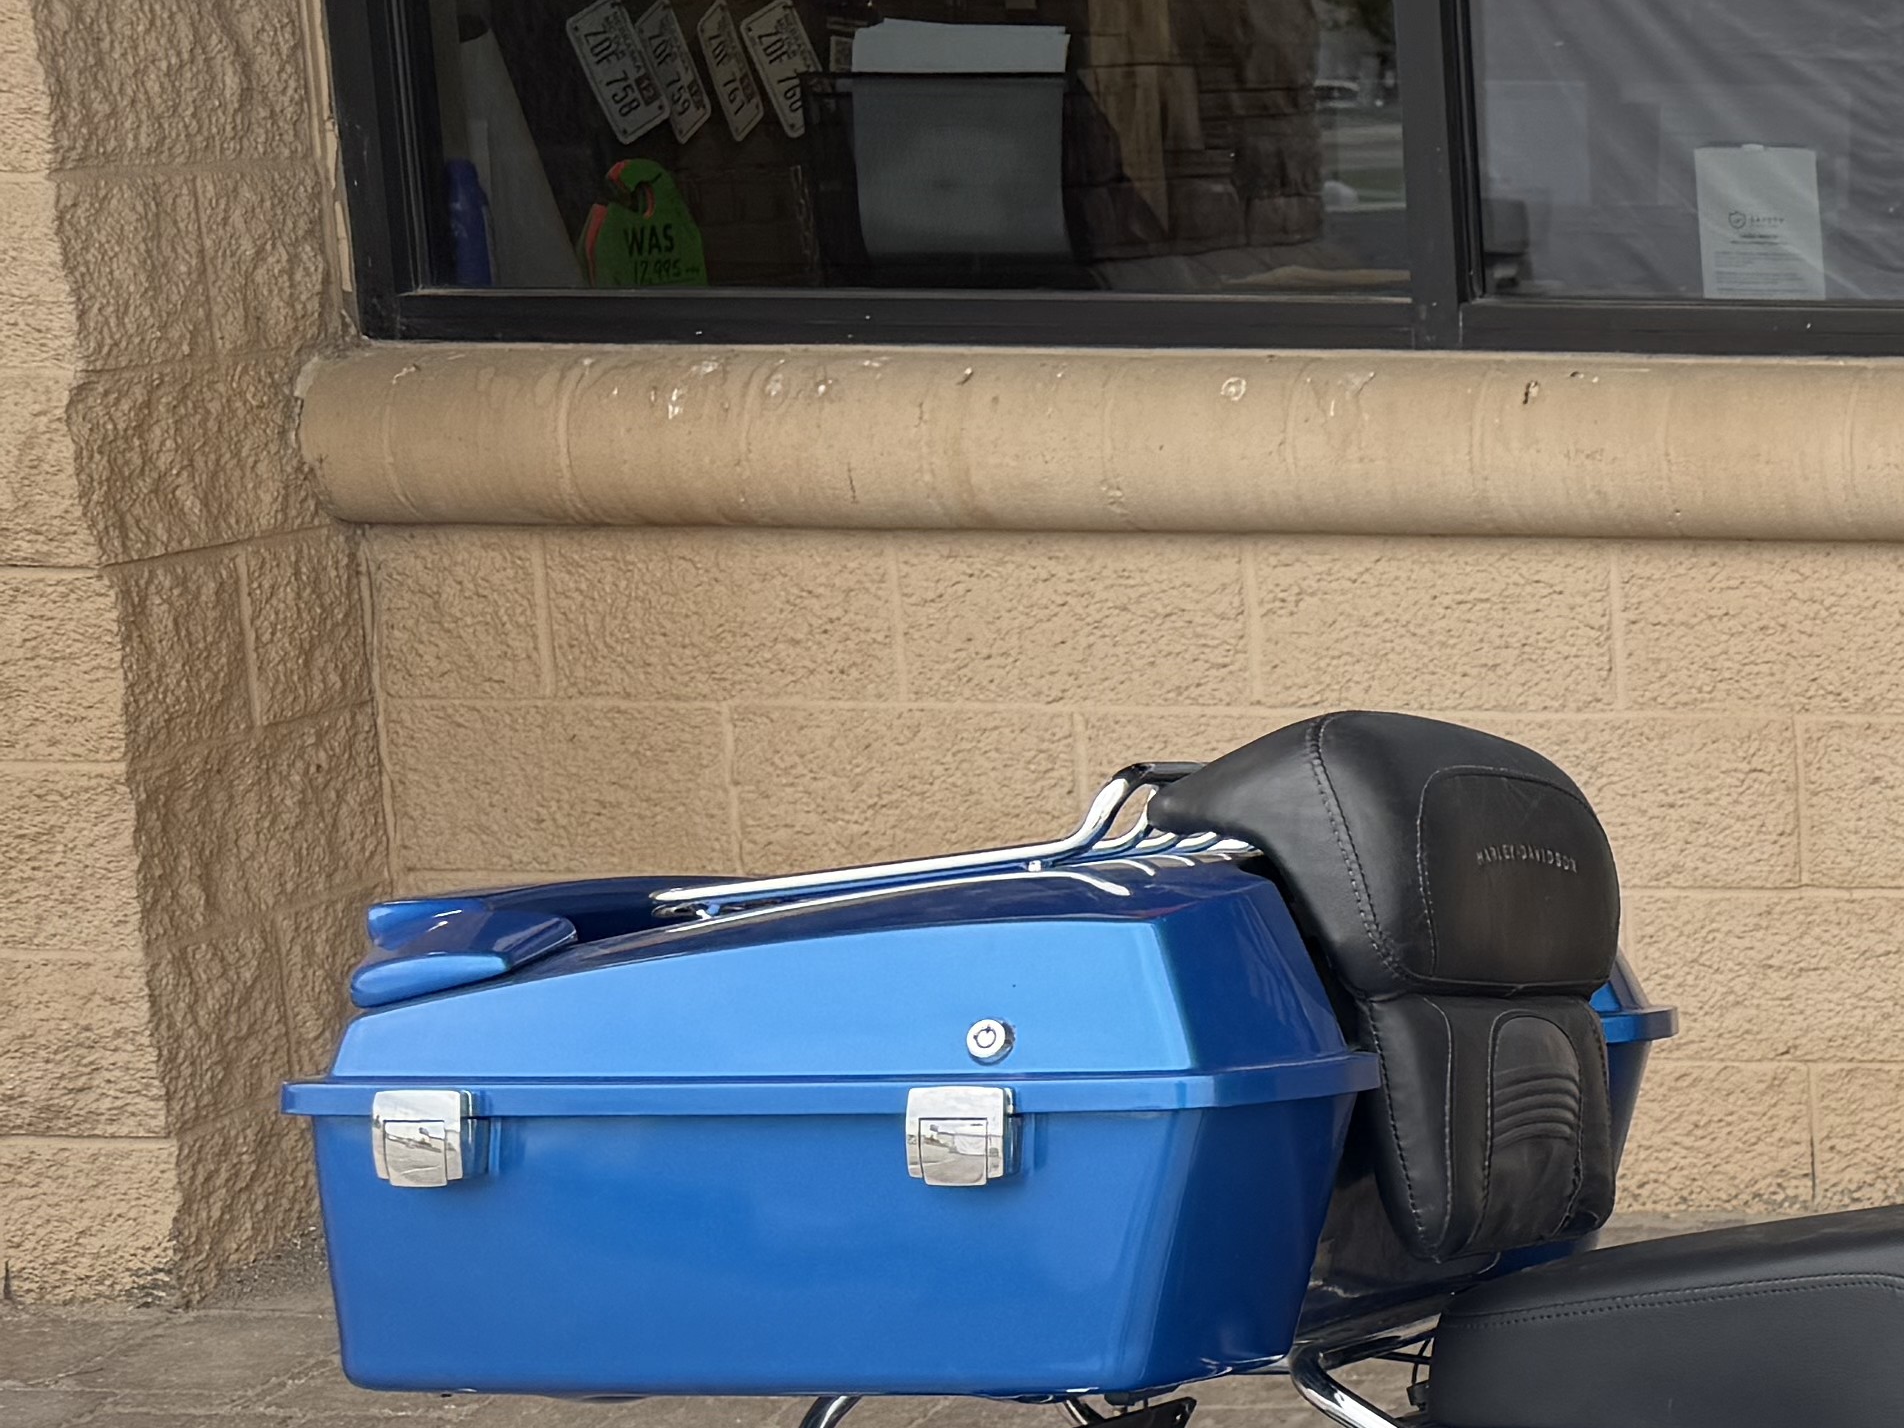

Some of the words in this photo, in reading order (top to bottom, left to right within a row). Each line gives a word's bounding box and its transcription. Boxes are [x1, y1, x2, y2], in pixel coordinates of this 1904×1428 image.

[604, 74, 641, 117] 758
[622, 222, 676, 258] WAS
[1475, 842, 1578, 875] HARLEY-DAVIDSON
